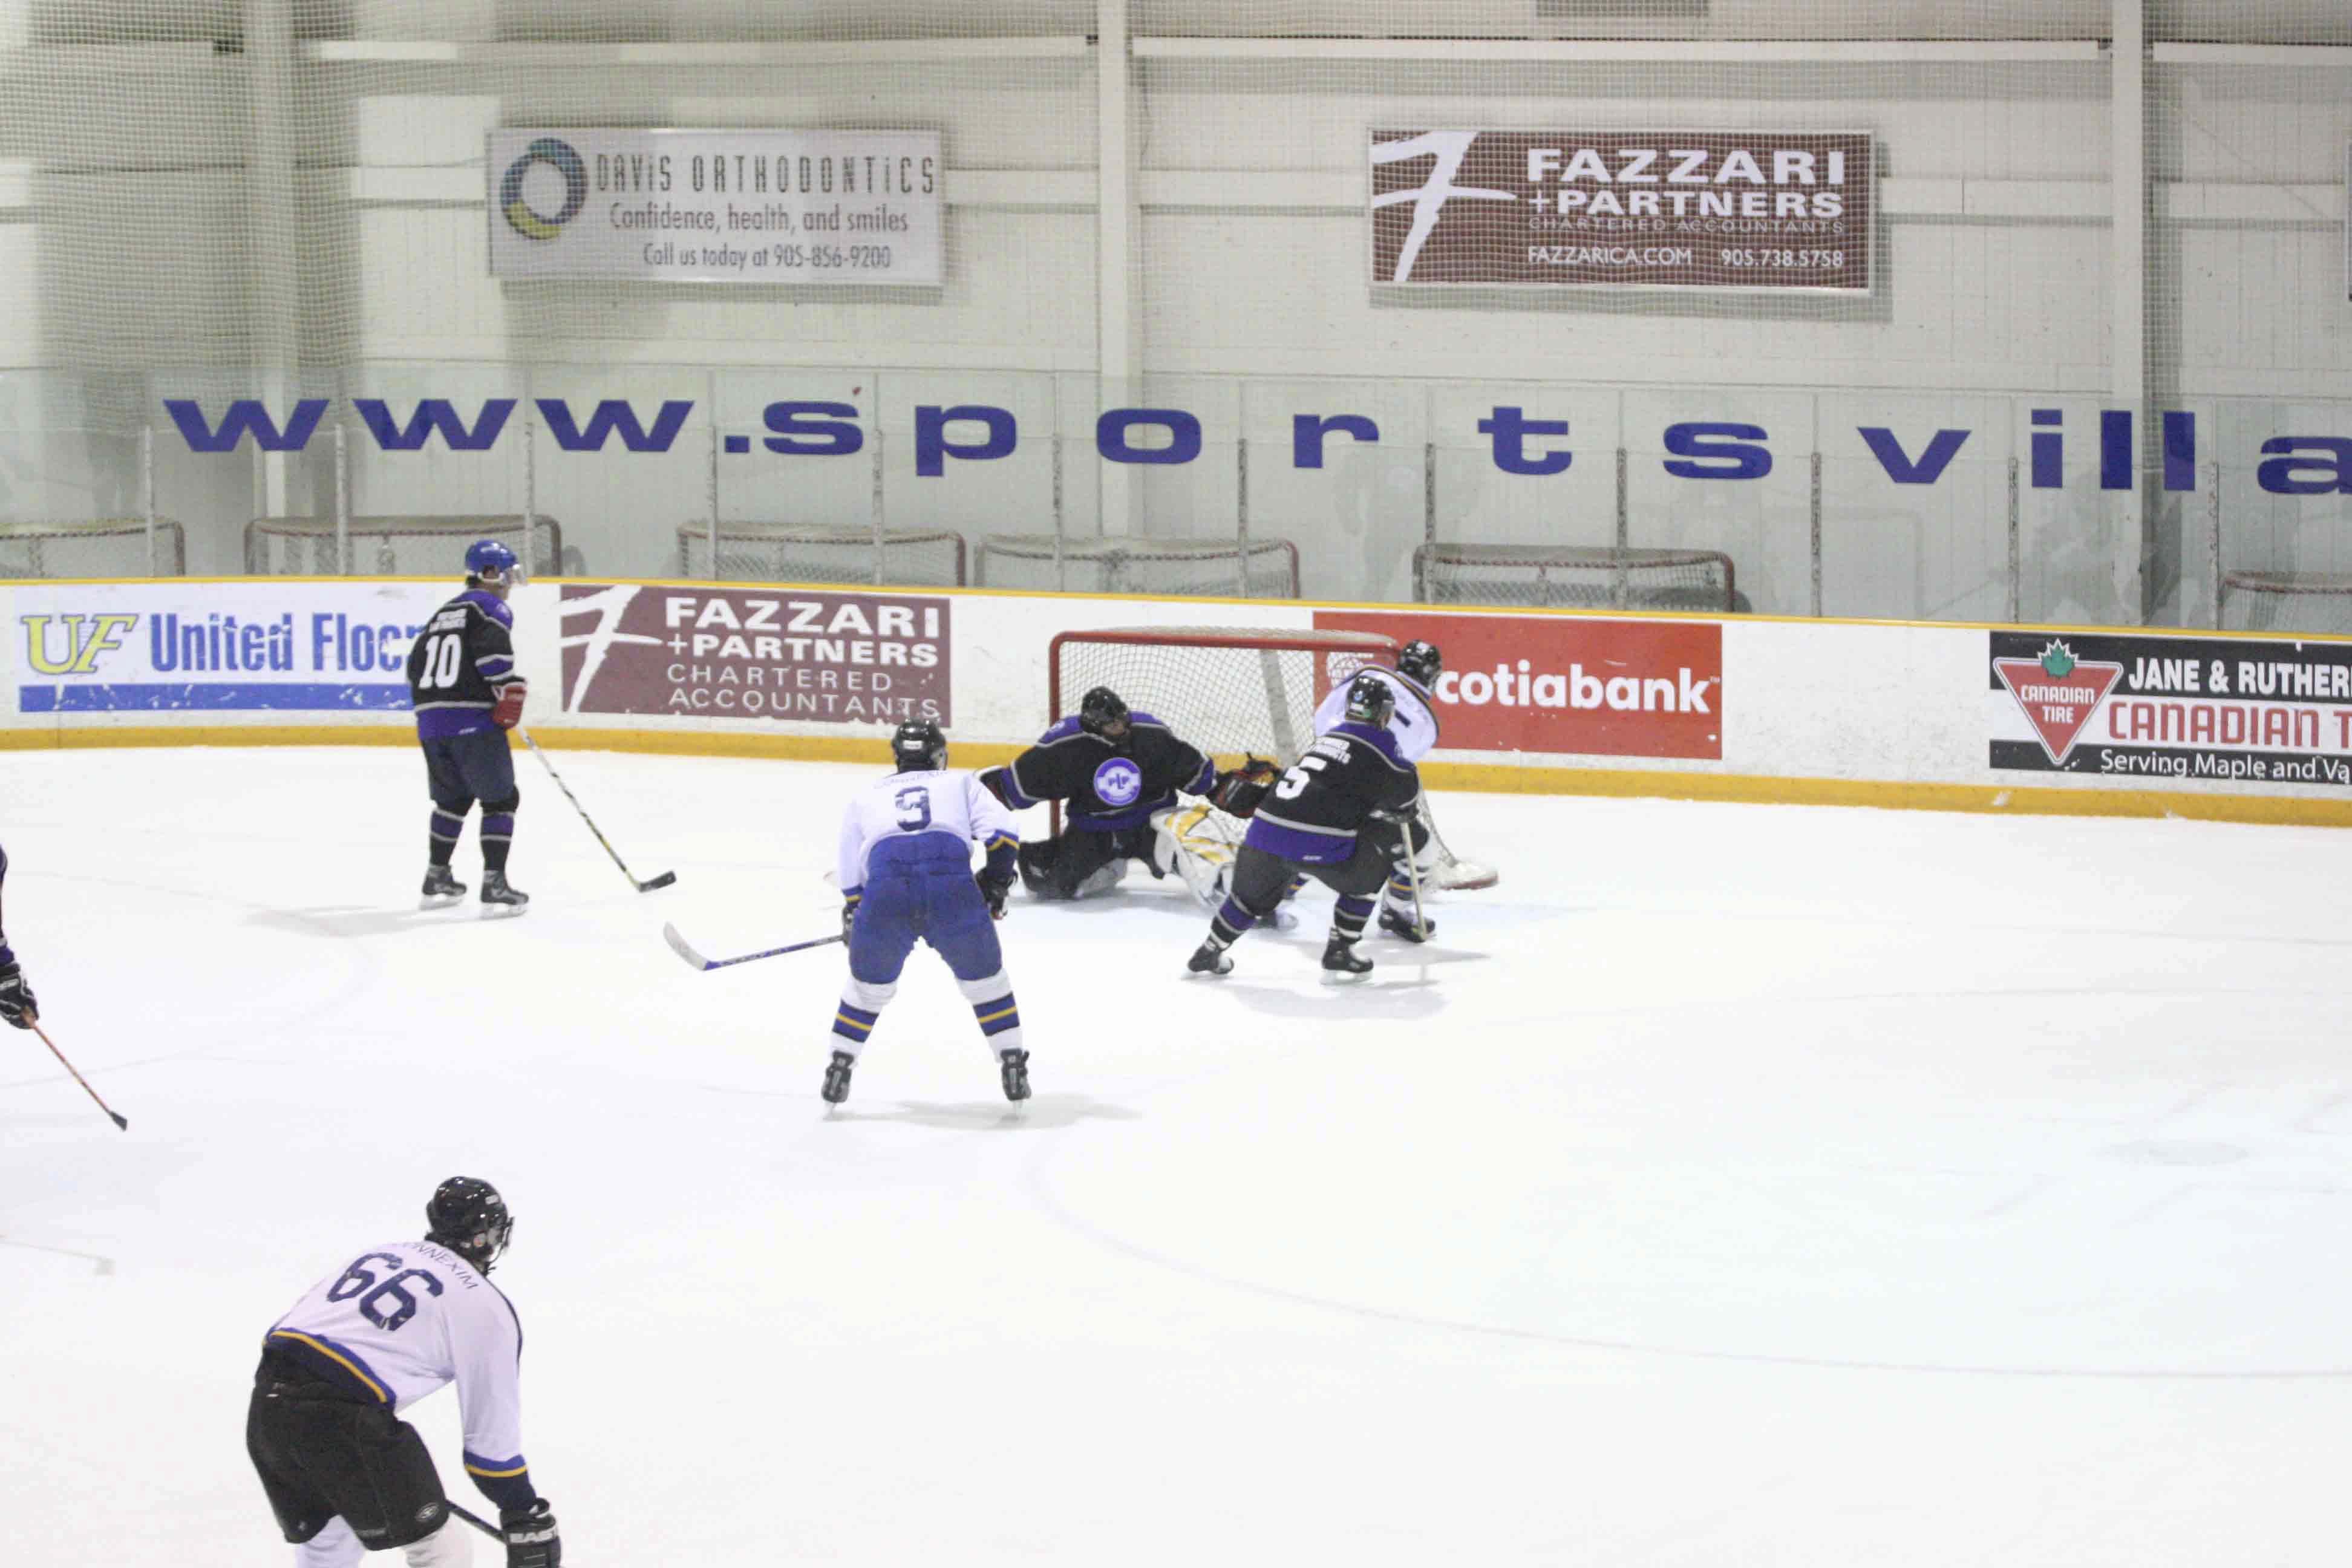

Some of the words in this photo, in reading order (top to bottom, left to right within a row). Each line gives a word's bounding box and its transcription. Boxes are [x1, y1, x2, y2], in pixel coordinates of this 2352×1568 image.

[1529, 149, 1843, 184] FAZZARI
[610, 203, 720, 234] Confidence,
[728, 204, 795, 234] health,
[804, 204, 839, 231] and
[848, 204, 909, 232] smiles
[1529, 217, 1665, 232] CHARTERED
[1677, 220, 1844, 234] ACCOUNTANTS
[644, 243, 674, 266] Call
[680, 249, 697, 266] us
[702, 245, 746, 270] today
[753, 245, 769, 267] at
[773, 245, 892, 269] 905-856-9200
[1529, 246, 1692, 266] FAZZARICA.COM
[1721, 249, 1843, 267] 905.738.5758
[666, 597, 939, 639] FAZZARI
[21, 613, 139, 674] UF
[150, 613, 292, 671] United
[419, 634, 462, 689] 10
[667, 663, 892, 692] CHARTERED
[2129, 657, 2200, 692] JANE
[2209, 659, 2230, 693] &
[2238, 661, 2352, 699] RUTHER
[668, 688, 941, 718] ACCOUNTANTS
[1436, 659, 1710, 713] cotiabank
[2020, 684, 2095, 705] CANADIAN
[2042, 705, 2074, 724] TIRE
[2109, 701, 2319, 748] CANADIAN
[1275, 756, 1327, 800] 5
[2100, 748, 2187, 777] Serving
[2197, 753, 2266, 780] Maple
[2273, 755, 2317, 780] and
[895, 786, 931, 832] 3
[327, 1252, 443, 1331] 66
